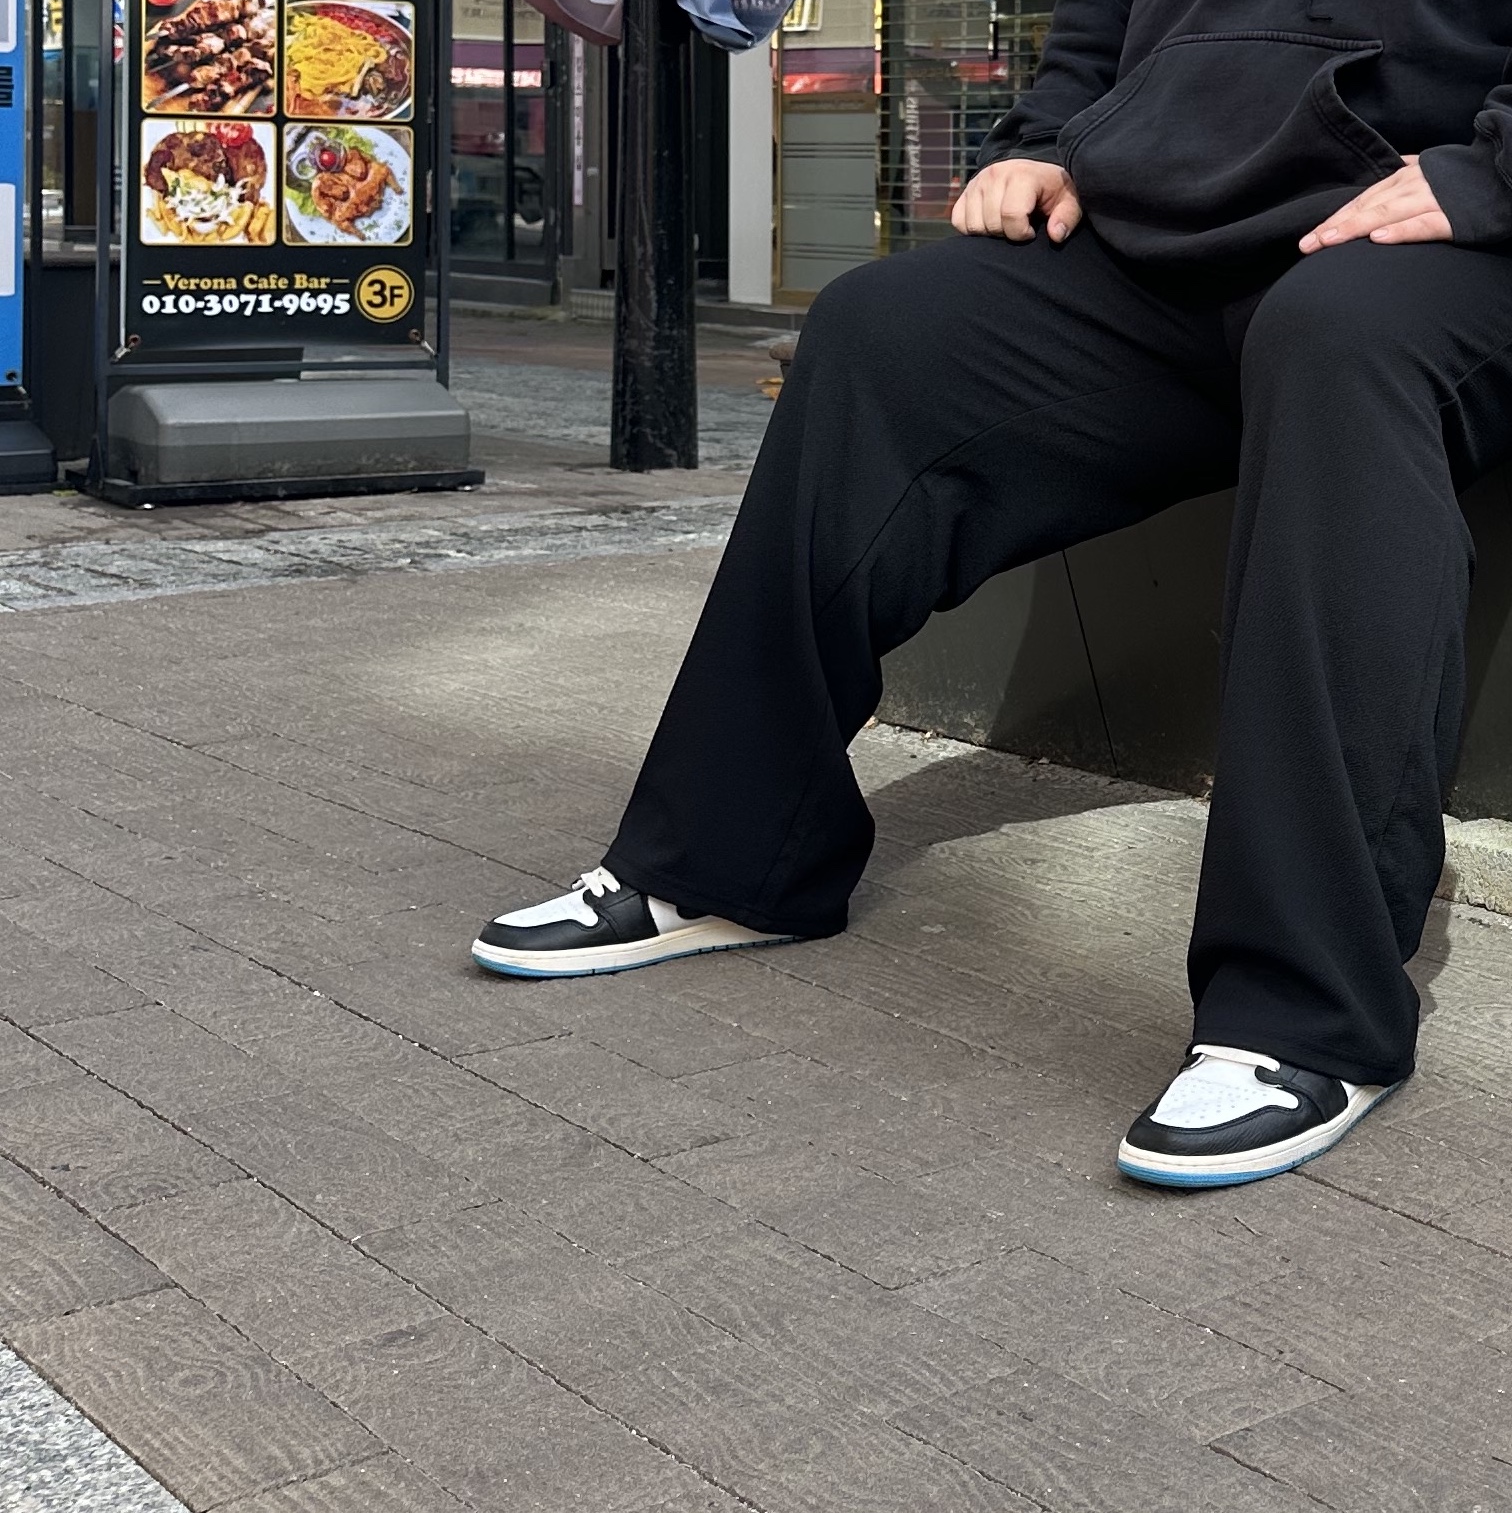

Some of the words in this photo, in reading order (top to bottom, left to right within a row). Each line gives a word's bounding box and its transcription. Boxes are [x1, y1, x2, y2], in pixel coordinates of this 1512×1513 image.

[164, 273, 237, 291] Verona
[243, 273, 288, 291] Cafe
[293, 274, 331, 291] Bar
[365, 278, 404, 309] 3F
[142, 293, 351, 316] 010-3071-9695
